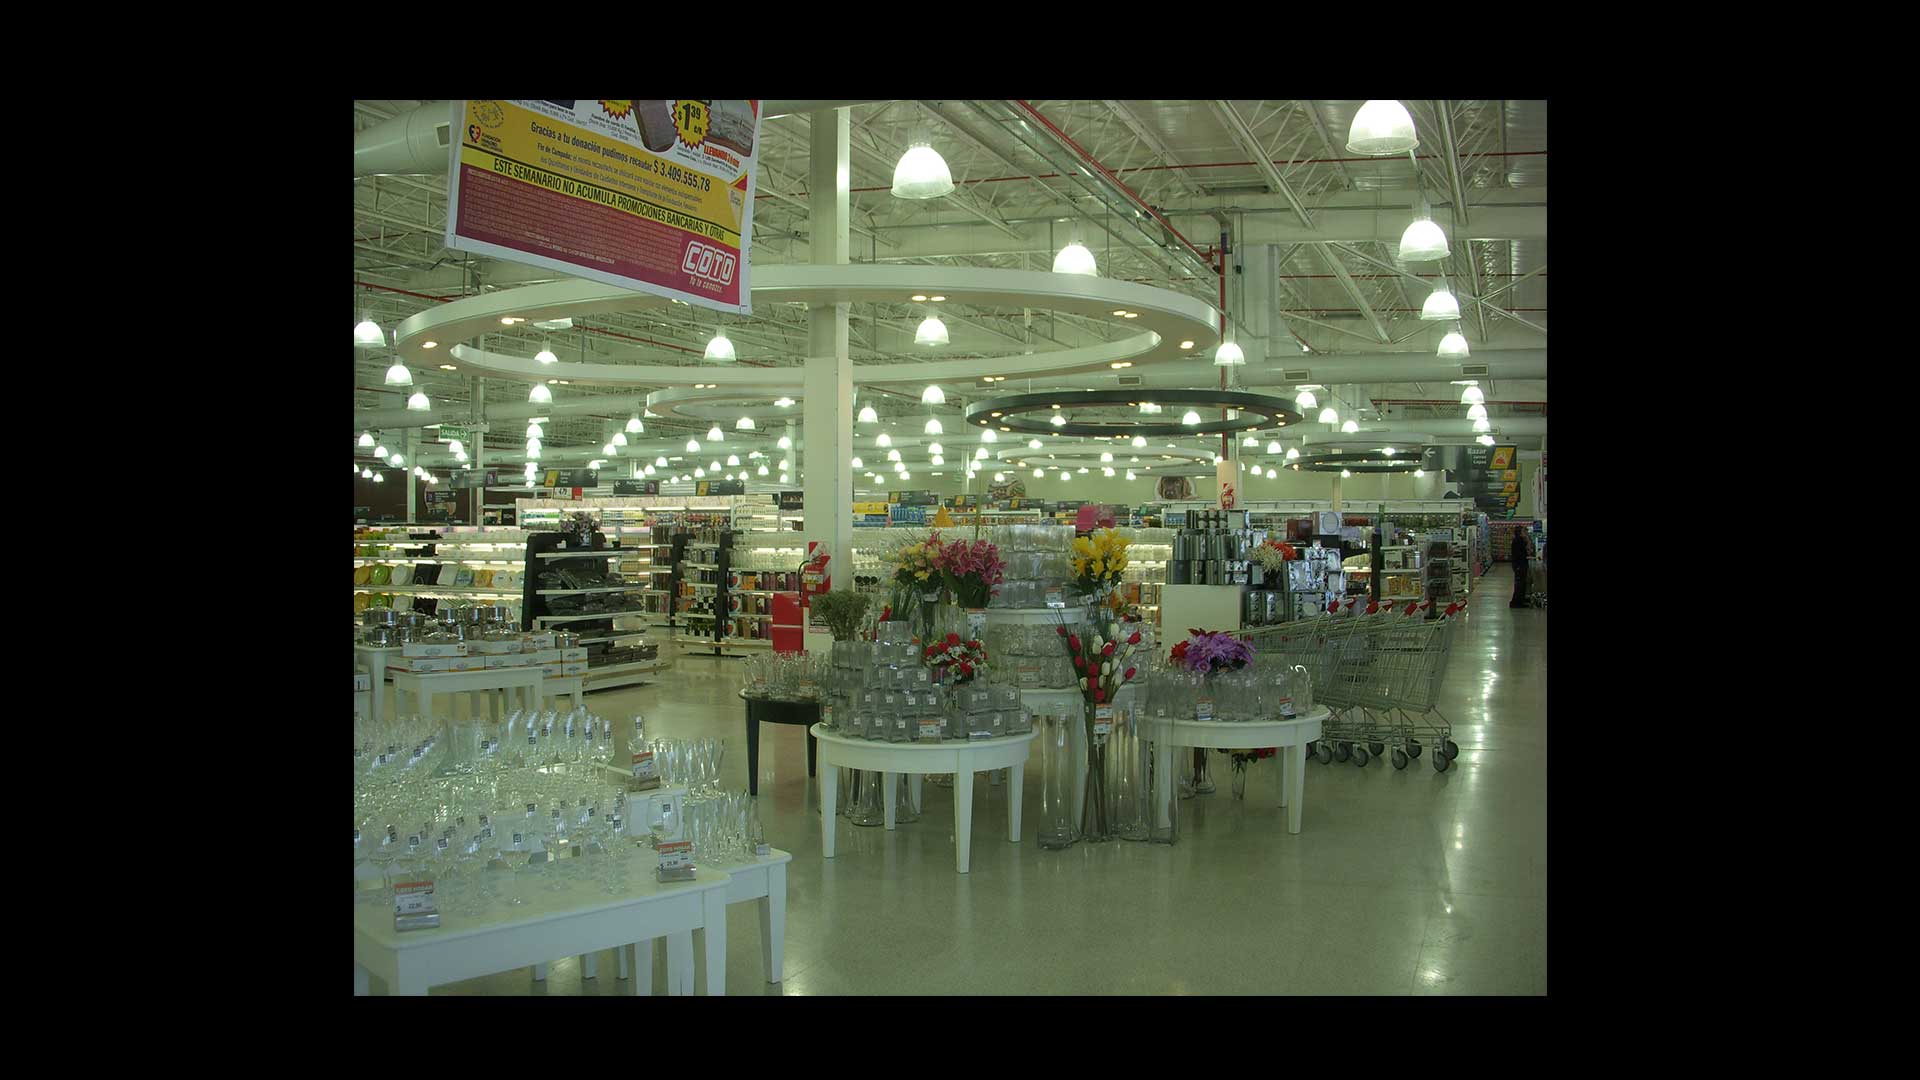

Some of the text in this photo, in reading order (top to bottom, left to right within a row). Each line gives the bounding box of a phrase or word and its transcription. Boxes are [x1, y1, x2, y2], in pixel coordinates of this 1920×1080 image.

[531, 121, 556, 139] Gracias
[557, 131, 562, 141] a
[563, 131, 571, 144] tu
[572, 133, 601, 154] donación
[602, 147, 629, 161] pudimos
[653, 160, 659, 174] $
[660, 163, 711, 192] 3.409.555,78
[494, 158, 512, 175] ESTE
[514, 163, 561, 190] SEMANARIO
[563, 180, 575, 194] NO
[576, 184, 616, 205] ACUMULA
[618, 195, 666, 221] PROMOCIONES
[667, 212, 703, 232] BANCARIAS
[704, 223, 709, 234] Y
[710, 225, 724, 241] OTRAS
[683, 241, 736, 285] COTO
